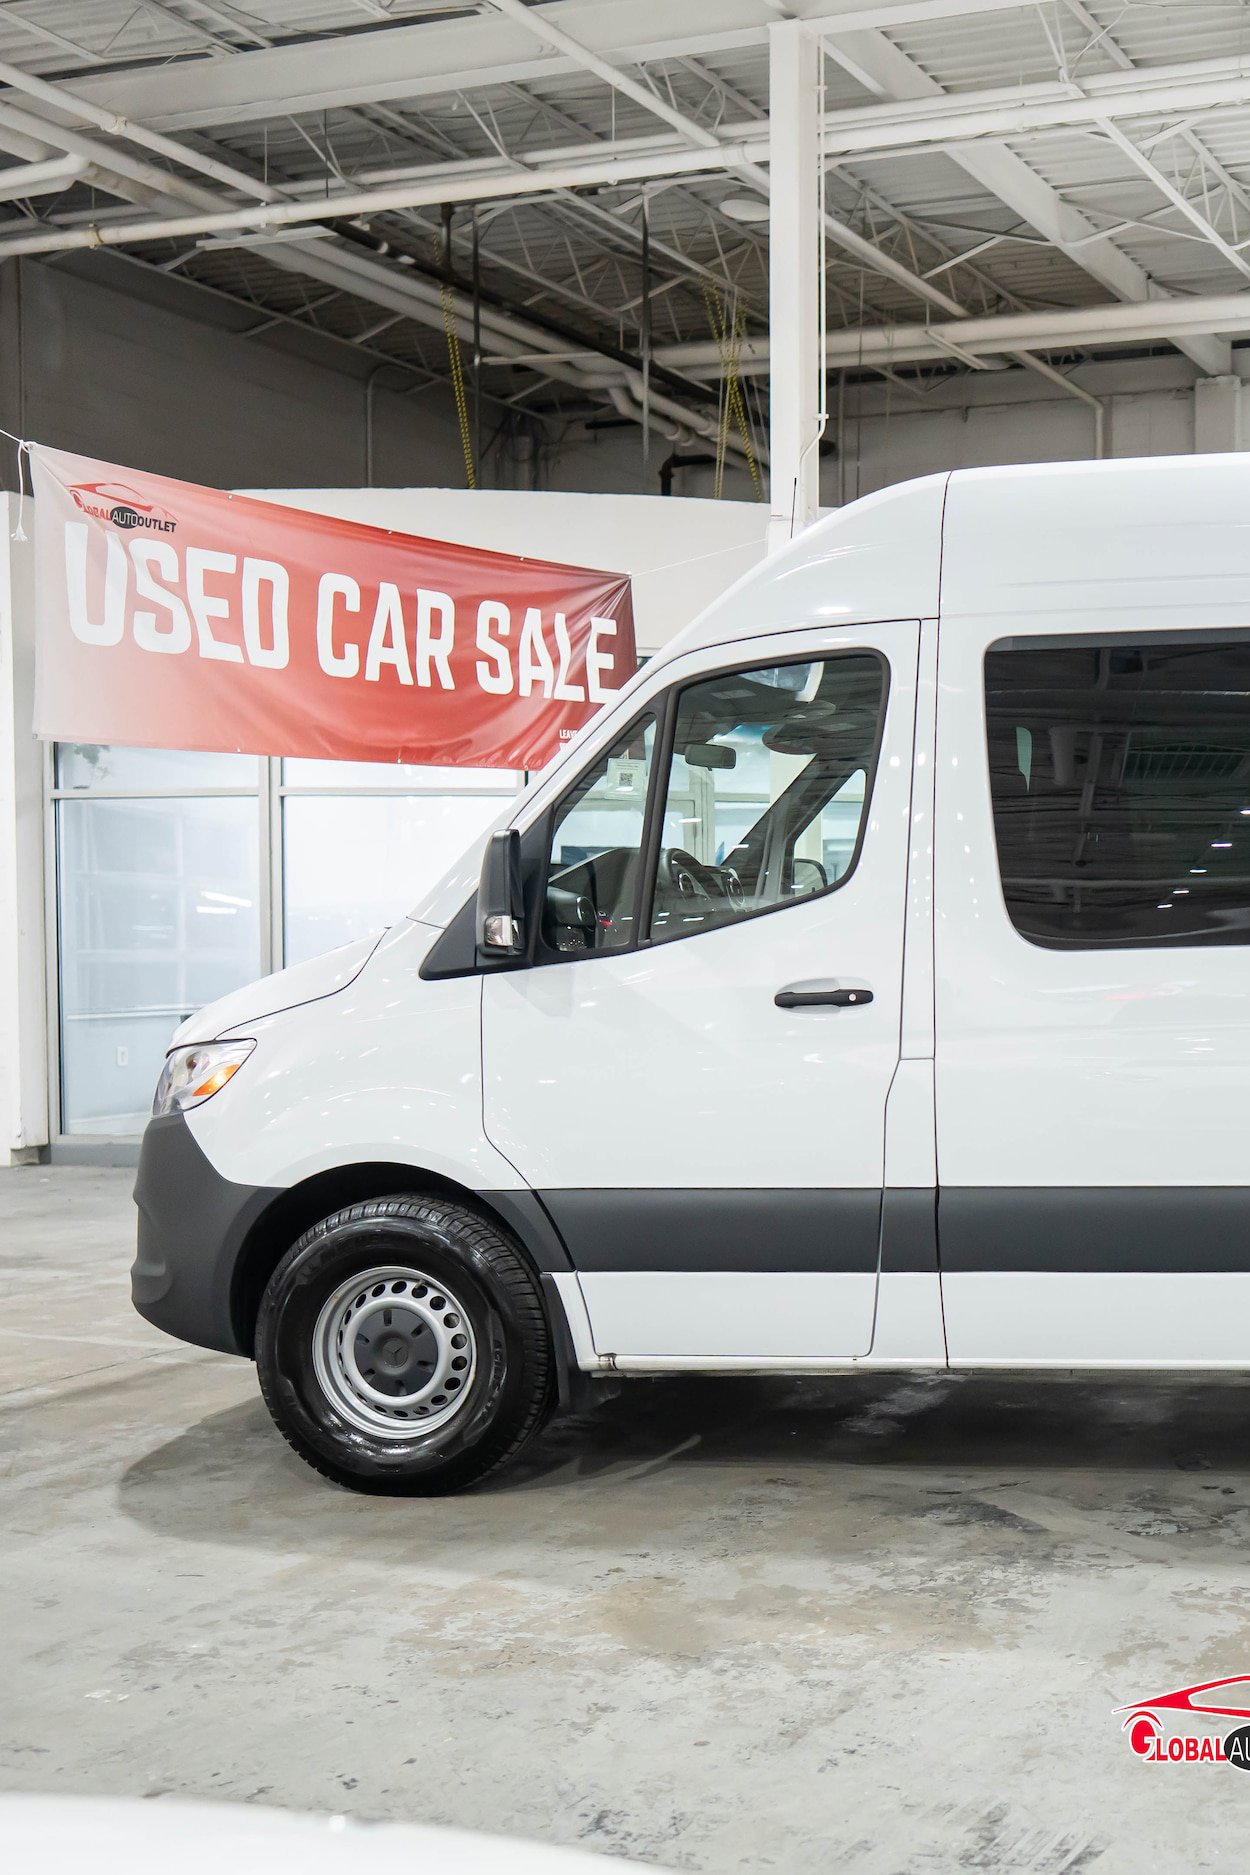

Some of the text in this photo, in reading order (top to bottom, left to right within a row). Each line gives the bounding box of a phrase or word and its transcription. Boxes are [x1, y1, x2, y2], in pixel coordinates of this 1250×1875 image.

[64, 522, 622, 704] USED CAR SALE
